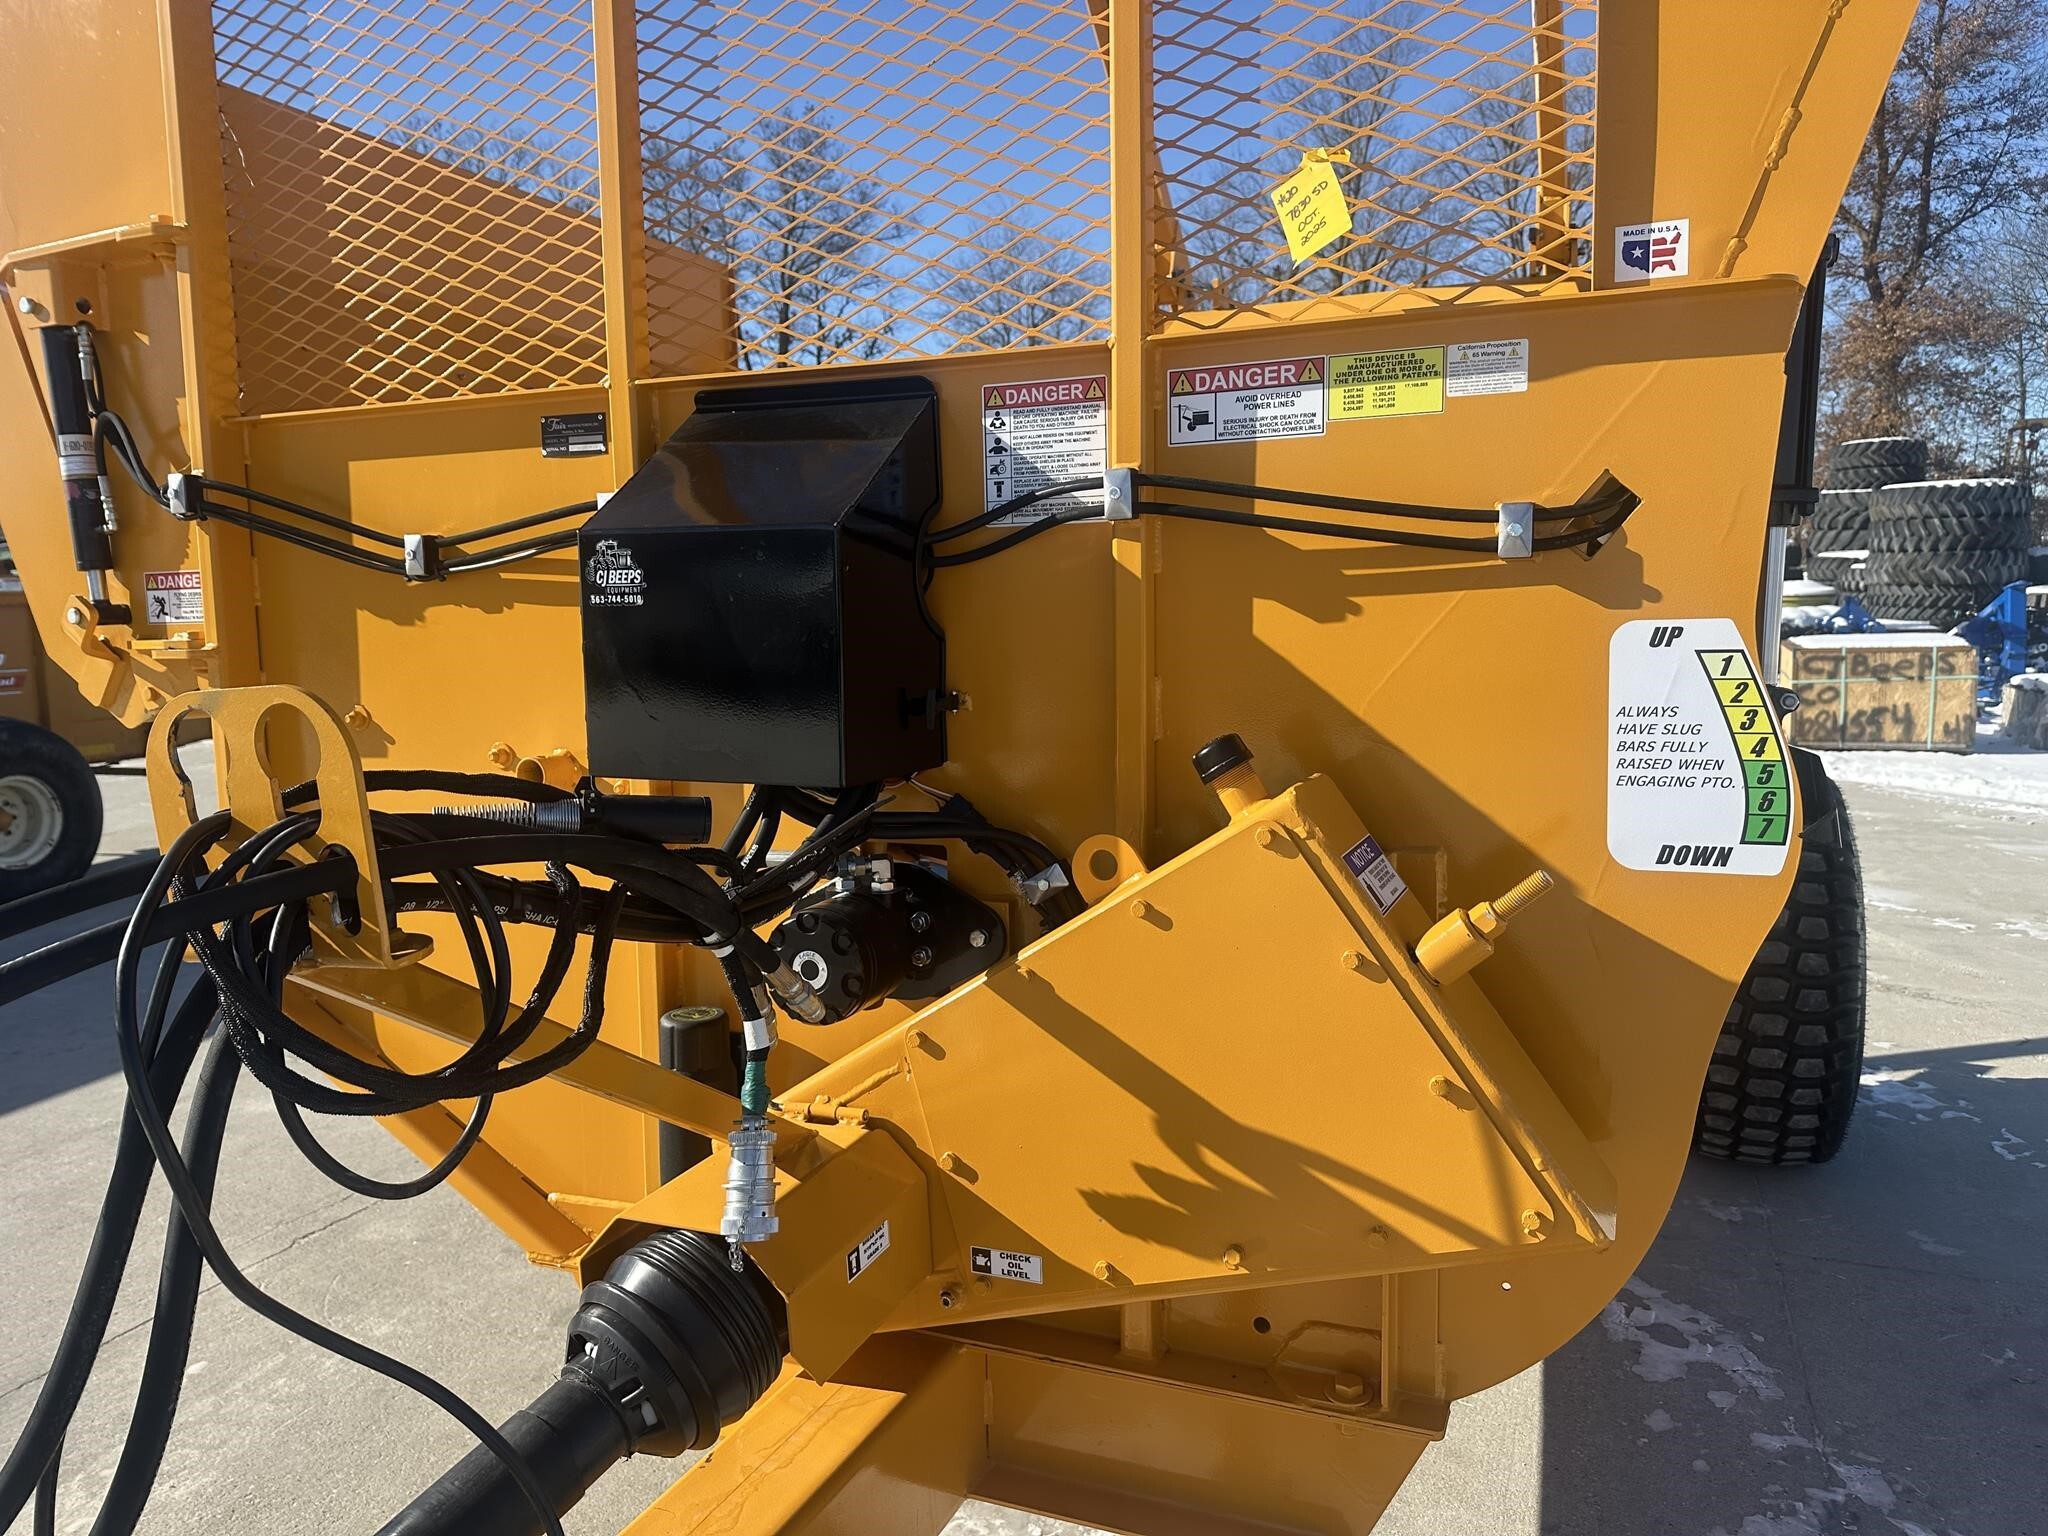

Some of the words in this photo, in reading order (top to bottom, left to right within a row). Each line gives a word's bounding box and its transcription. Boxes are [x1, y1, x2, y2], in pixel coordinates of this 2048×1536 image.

[1285, 195, 1311, 221] 7830
[1312, 180, 1328, 196] SD
[1301, 216, 1327, 246] 2025
[1623, 229, 1646, 237] MADE
[1657, 225, 1681, 233] U.S.A.
[1457, 344, 1486, 352] California
[1486, 341, 1521, 349] Proposition
[1347, 358, 1425, 371] MANUFACTURERED
[1375, 354, 1406, 362] DEVICE
[1336, 370, 1363, 379] UNDER
[1399, 365, 1423, 373] MORE
[1425, 363, 1437, 371] OF
[1351, 373, 1400, 384] FOLLOWING
[1401, 371, 1441, 380] PATENTS:
[1195, 364, 1298, 392] DANGER
[1005, 383, 1084, 405] DANGER
[1235, 395, 1258, 403] AVOID
[1259, 391, 1302, 401] OVERHEAD
[1243, 401, 1272, 411] POWER
[1273, 399, 1296, 409] LINES
[547, 418, 566, 431] Fair
[1248, 416, 1269, 424] INJURY
[1244, 427, 1281, 436] CONTACTING
[157, 574, 201, 589] DANGE
[596, 570, 607, 587] CJ
[608, 570, 641, 584] BEEPS
[590, 595, 642, 604] 563-744-5010
[1648, 626, 1684, 648] UP
[1719, 654, 1734, 676] 1
[1729, 681, 1749, 704] 2
[1616, 706, 1679, 718] ALWAYS
[1739, 709, 1758, 731] 3
[1616, 723, 1658, 735] HAVE
[1661, 723, 1703, 735] SLUG
[1616, 741, 1655, 753] BARS
[1660, 741, 1708, 753] FULLY
[1749, 736, 1769, 757] 4
[1616, 758, 1675, 770] RAISED
[1678, 759, 1724, 771] WHEN
[1756, 764, 1776, 785] 5
[1616, 775, 1695, 788] ENGAGING
[1701, 776, 1736, 789] PTO.
[1757, 790, 1777, 812] 6
[1757, 817, 1774, 839] 7
[1350, 842, 1375, 869] NOTICE
[1655, 844, 1734, 867] DOWN
[1000, 1252, 1031, 1263] CHECK
[1008, 1262, 1023, 1270] OIL
[1001, 1269, 1031, 1279] LEVEL
